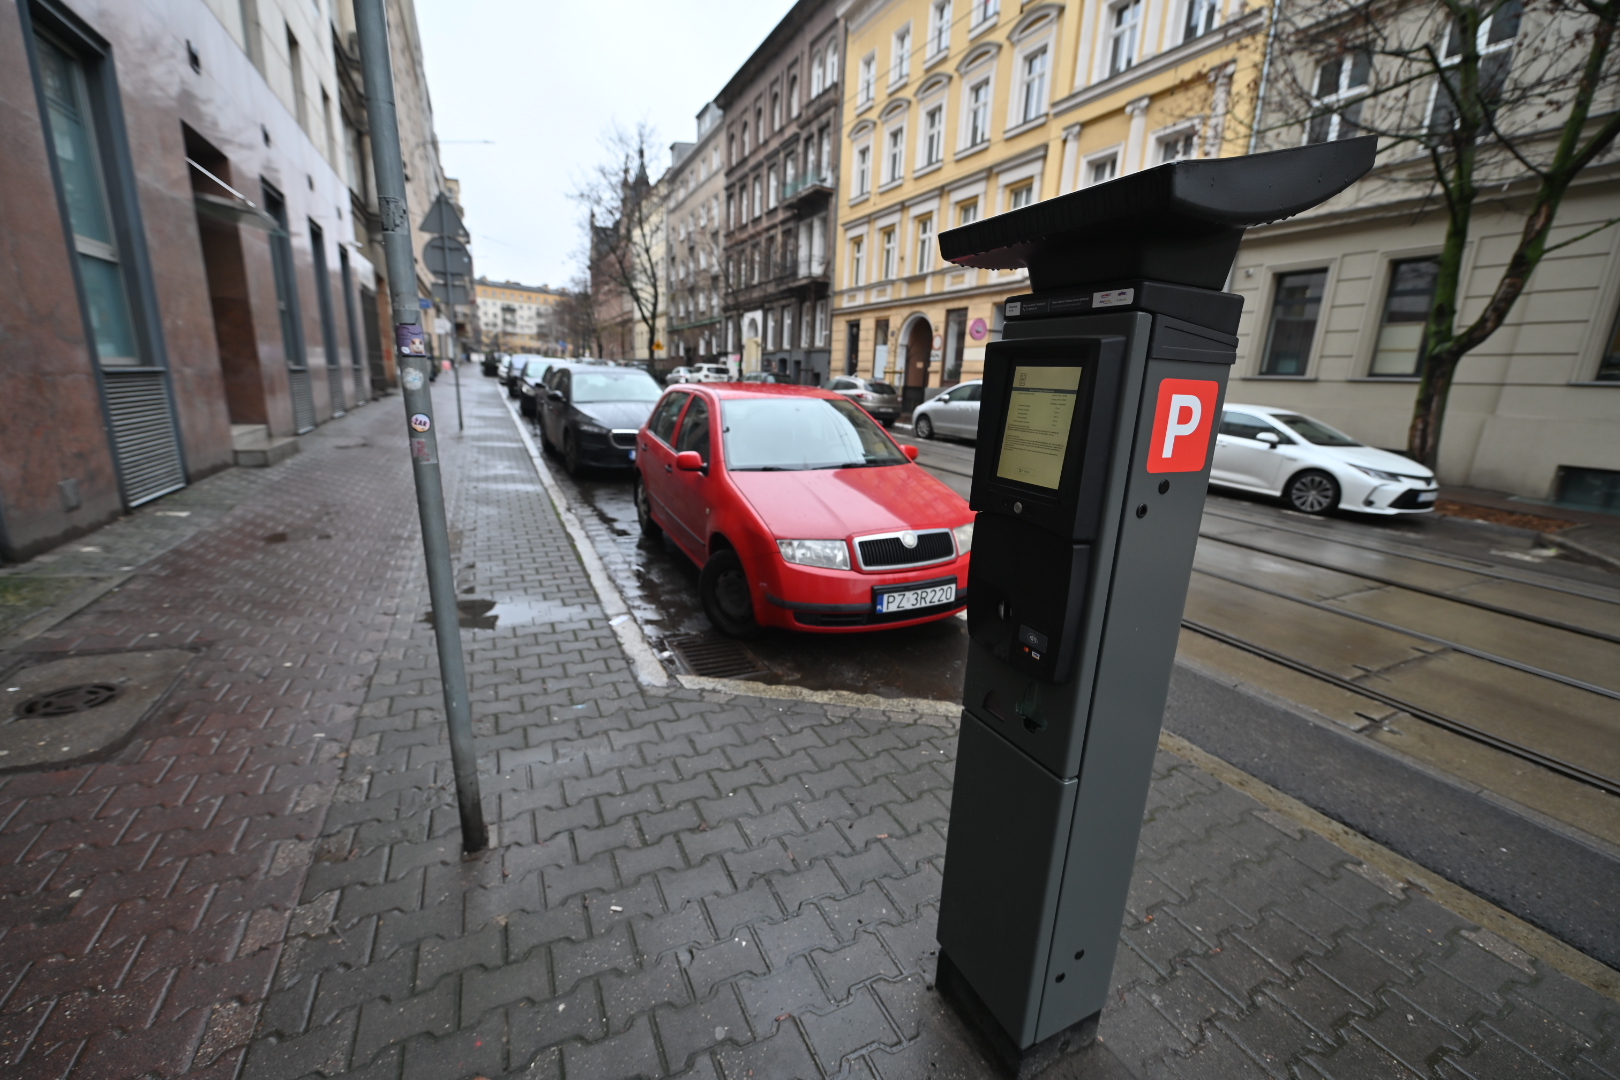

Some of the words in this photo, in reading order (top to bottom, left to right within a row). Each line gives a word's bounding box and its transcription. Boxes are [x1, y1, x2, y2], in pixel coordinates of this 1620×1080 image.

[414, 417, 428, 427] ŻAR
[1162, 394, 1202, 458] P
[886, 593, 906, 610] PZ
[911, 586, 953, 607] 3R220
